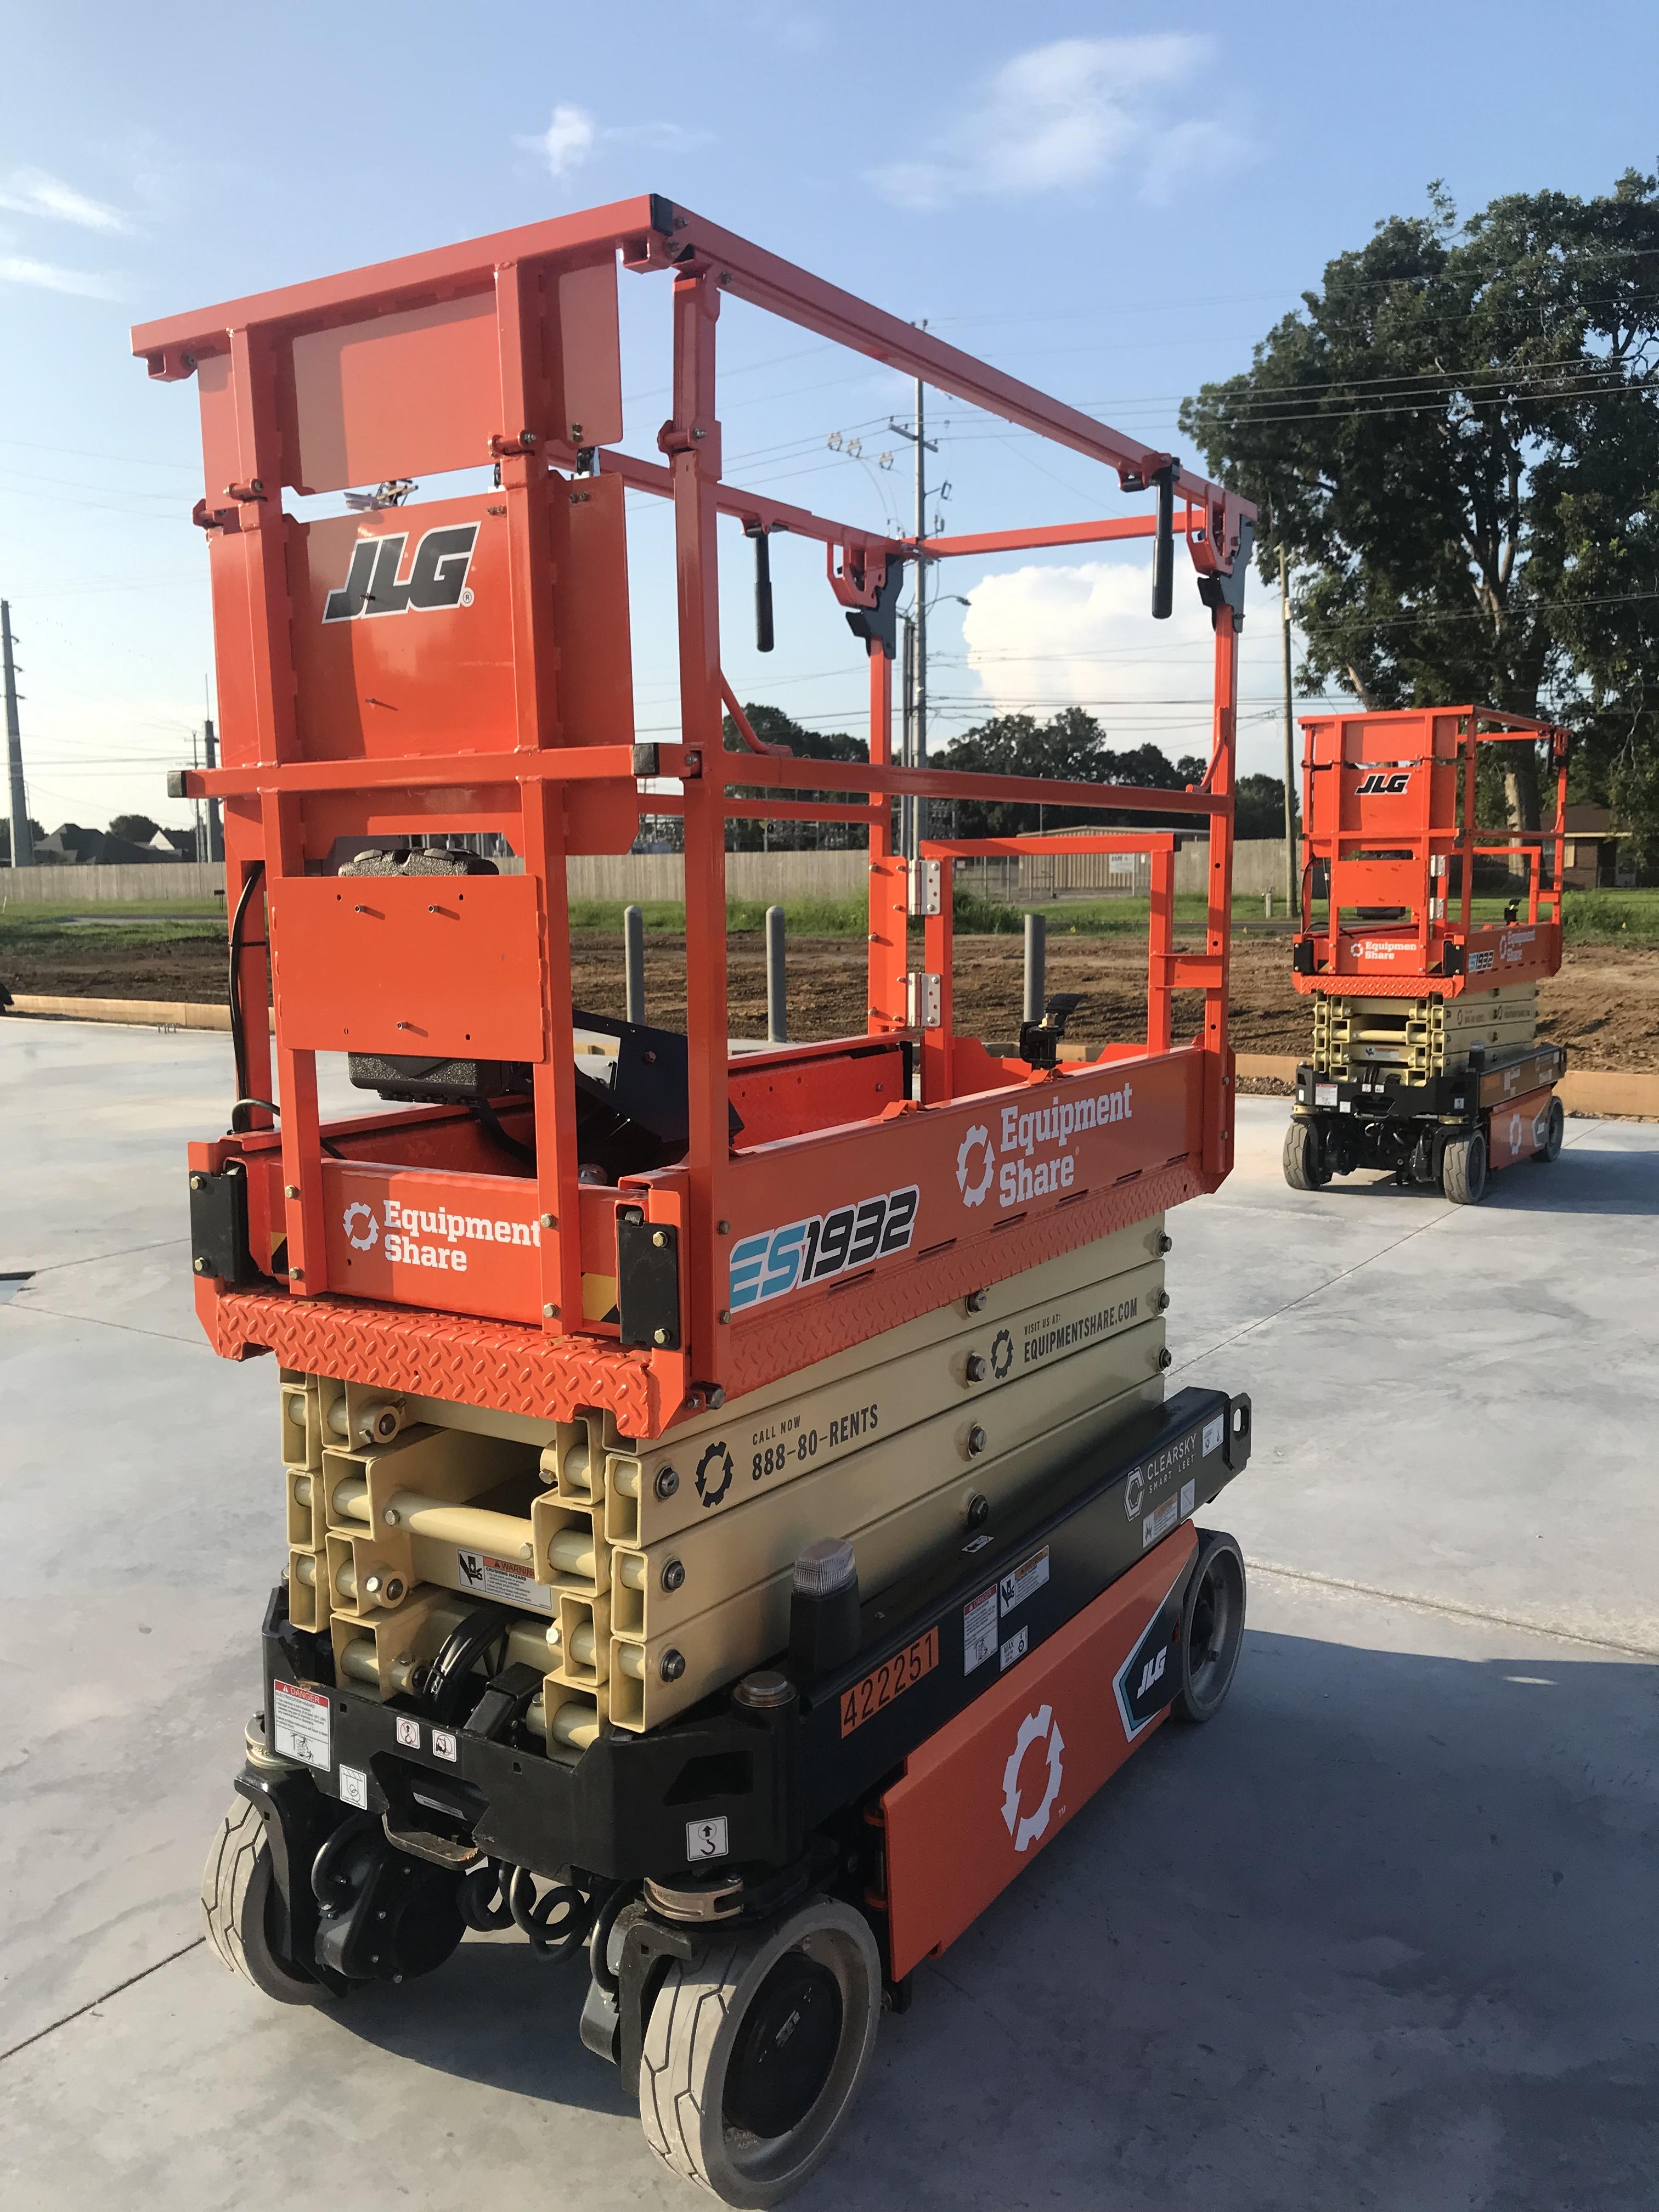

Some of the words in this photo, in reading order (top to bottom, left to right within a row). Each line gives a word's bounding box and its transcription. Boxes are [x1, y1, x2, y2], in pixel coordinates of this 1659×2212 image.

[322, 522, 481, 624] JLG
[1355, 773, 1411, 795] JLG
[1365, 951, 1395, 960] Share
[1000, 1082, 1132, 1156] Equipment
[1000, 1154, 1074, 1207] Share
[383, 1199, 541, 1248] Equipment
[384, 1234, 467, 1272] Share
[730, 1187, 919, 1312] ES1932
[1024, 1321, 1040, 1335] VISIT
[1042, 1318, 1049, 1328] US
[1052, 1313, 1060, 1324] AT:
[1024, 1297, 1138, 1363] EQUIPMENTSHARE.COM
[752, 1403, 878, 1481] 888-80-RENTS
[753, 1426, 776, 1446] CALL
[780, 1415, 801, 1434] NOW
[1147, 1432, 1197, 1480] CLEARSKY
[1149, 1470, 1172, 1494] SMART
[486, 1567, 507, 1576] CRUSHING
[509, 1573, 527, 1581] HAZARD
[1004, 1640, 1014, 1654] MAX
[290, 1687, 320, 1704] DANGER
[843, 1632, 933, 1728] 422251
[1137, 1645, 1167, 1699] JLG
